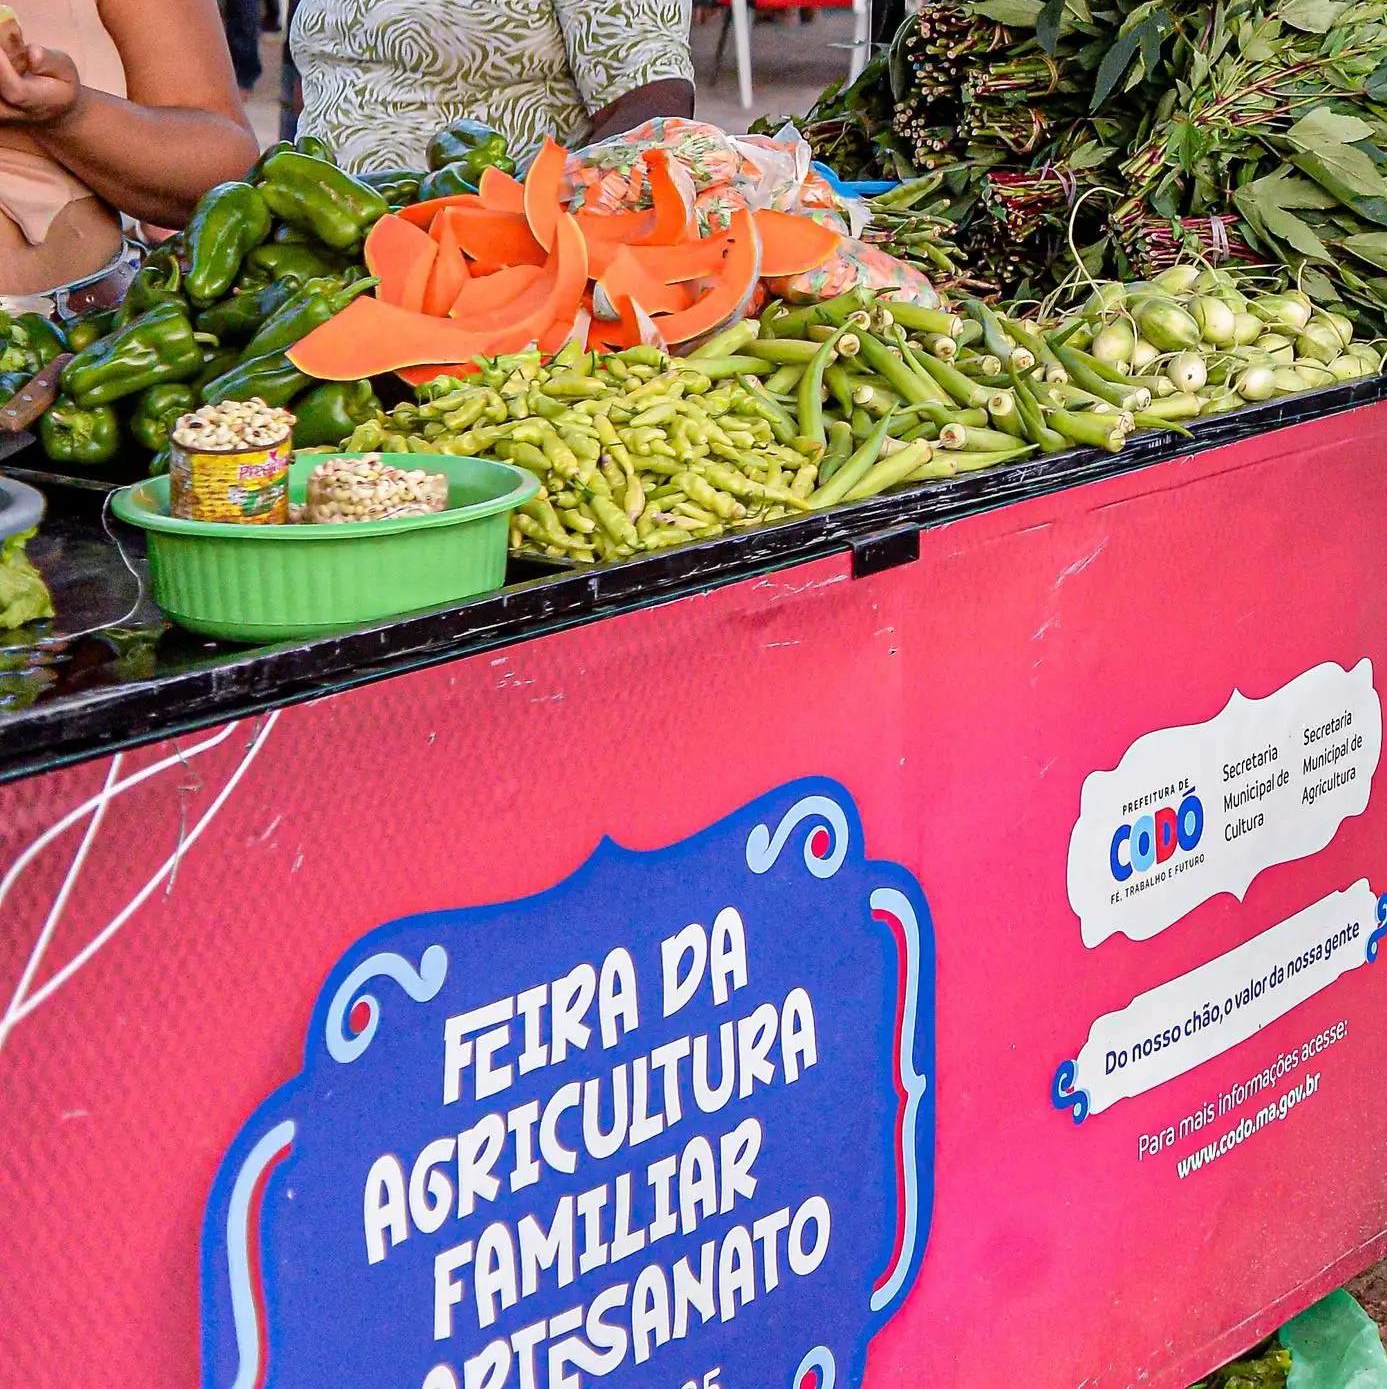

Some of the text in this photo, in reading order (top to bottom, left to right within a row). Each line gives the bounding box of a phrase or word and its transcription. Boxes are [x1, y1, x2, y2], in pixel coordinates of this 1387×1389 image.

[1222, 744, 1278, 782] Secretaria
[1302, 733, 1363, 775] Municipal de
[1303, 710, 1352, 746] Secretaria
[1122, 778, 1190, 816] PREFEITURA DE
[1223, 768, 1290, 813] Municipal de
[1302, 767, 1356, 805] Agricultura
[1110, 785, 1204, 882] CODÓ
[1224, 813, 1264, 842] Cultura
[1125, 871, 1166, 898] TRABALHO
[1168, 867, 1173, 878] E
[1174, 853, 1205, 875] FUTURO
[443, 907, 748, 1105] FEIRA DA
[1105, 1048, 1127, 1075] Do
[1132, 1025, 1181, 1062] nosso
[1234, 975, 1268, 1008] valor
[1269, 965, 1285, 989] da
[1286, 945, 1323, 979] nossa
[1324, 922, 1360, 962] gente
[1138, 1019, 1349, 1161] Para mais informações acesse:
[1176, 1071, 1321, 1180] www.codo.ma.gov.br
[364, 987, 818, 1265] AGRICULTURA
[434, 1118, 762, 1341] FAMILIAR
[421, 1196, 831, 1389] RTESANATO
